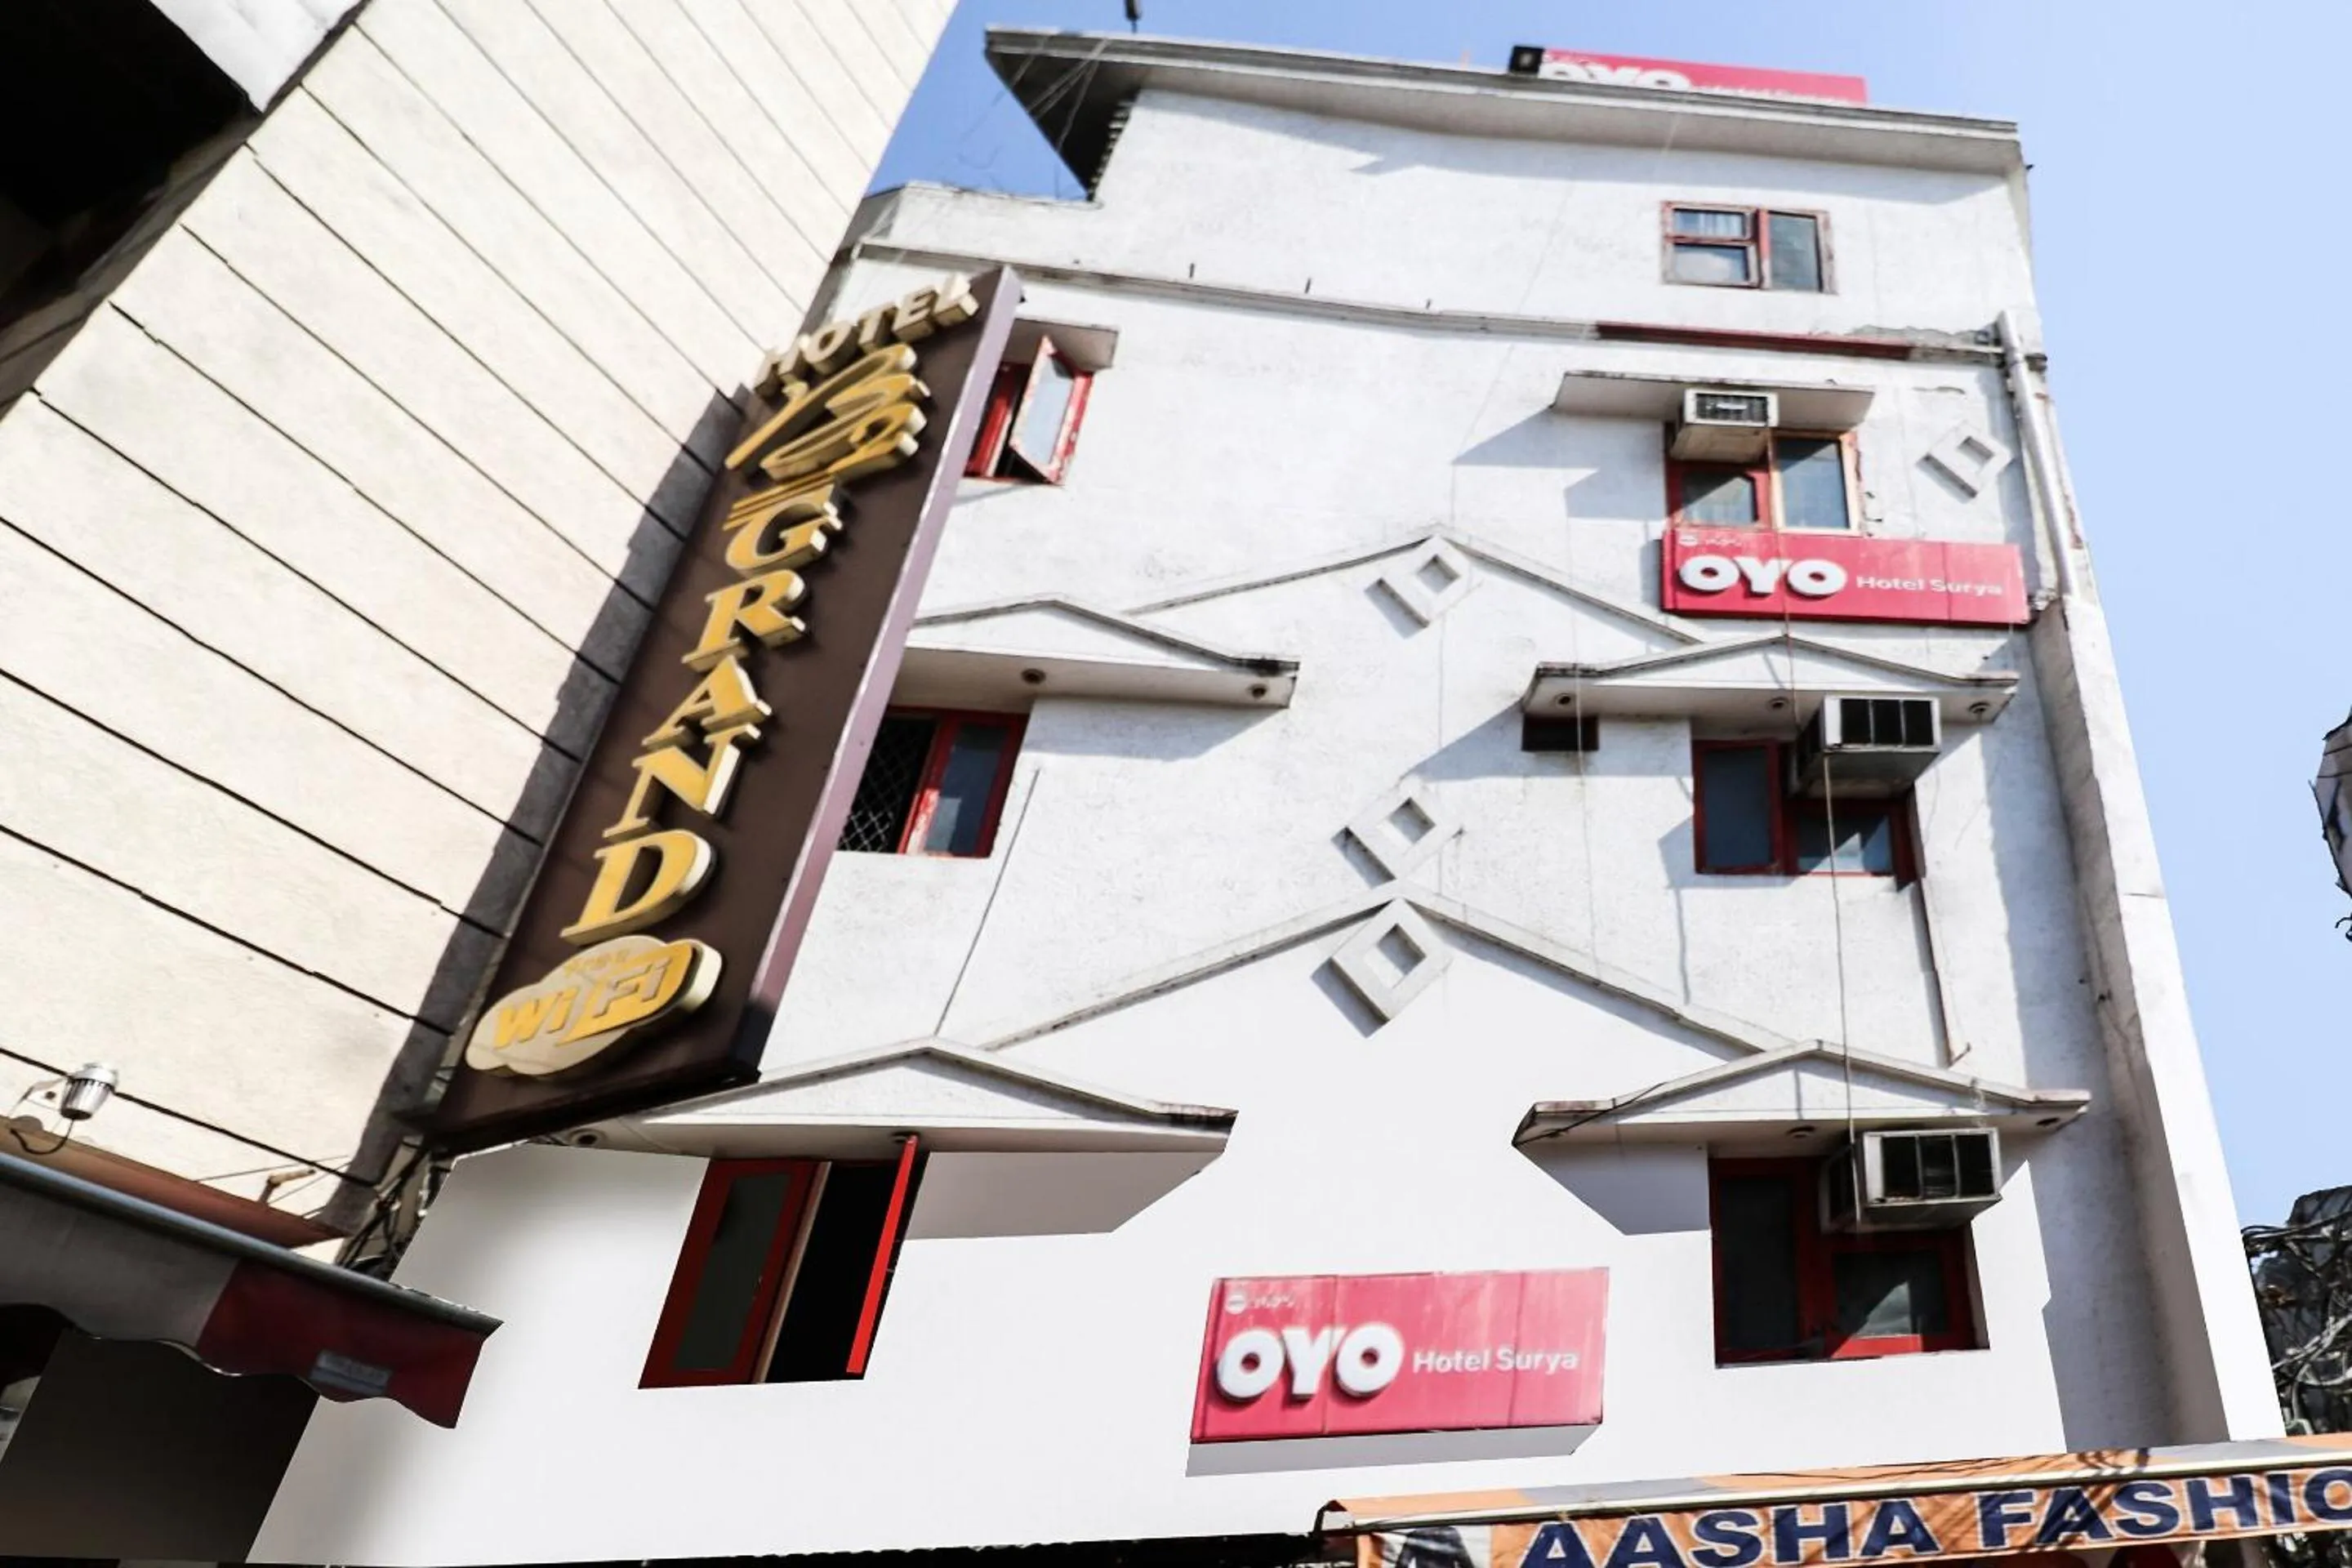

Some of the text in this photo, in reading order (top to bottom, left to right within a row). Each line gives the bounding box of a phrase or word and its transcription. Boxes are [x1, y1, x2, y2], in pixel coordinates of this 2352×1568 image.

[754, 273, 979, 397] HOTEL
[1678, 555, 2004, 598] OYO Hotel Surya
[559, 483, 841, 946] GRAND
[1216, 1321, 1580, 1401] OYO Hotel Surya
[1517, 1498, 1942, 1568] AASHA
